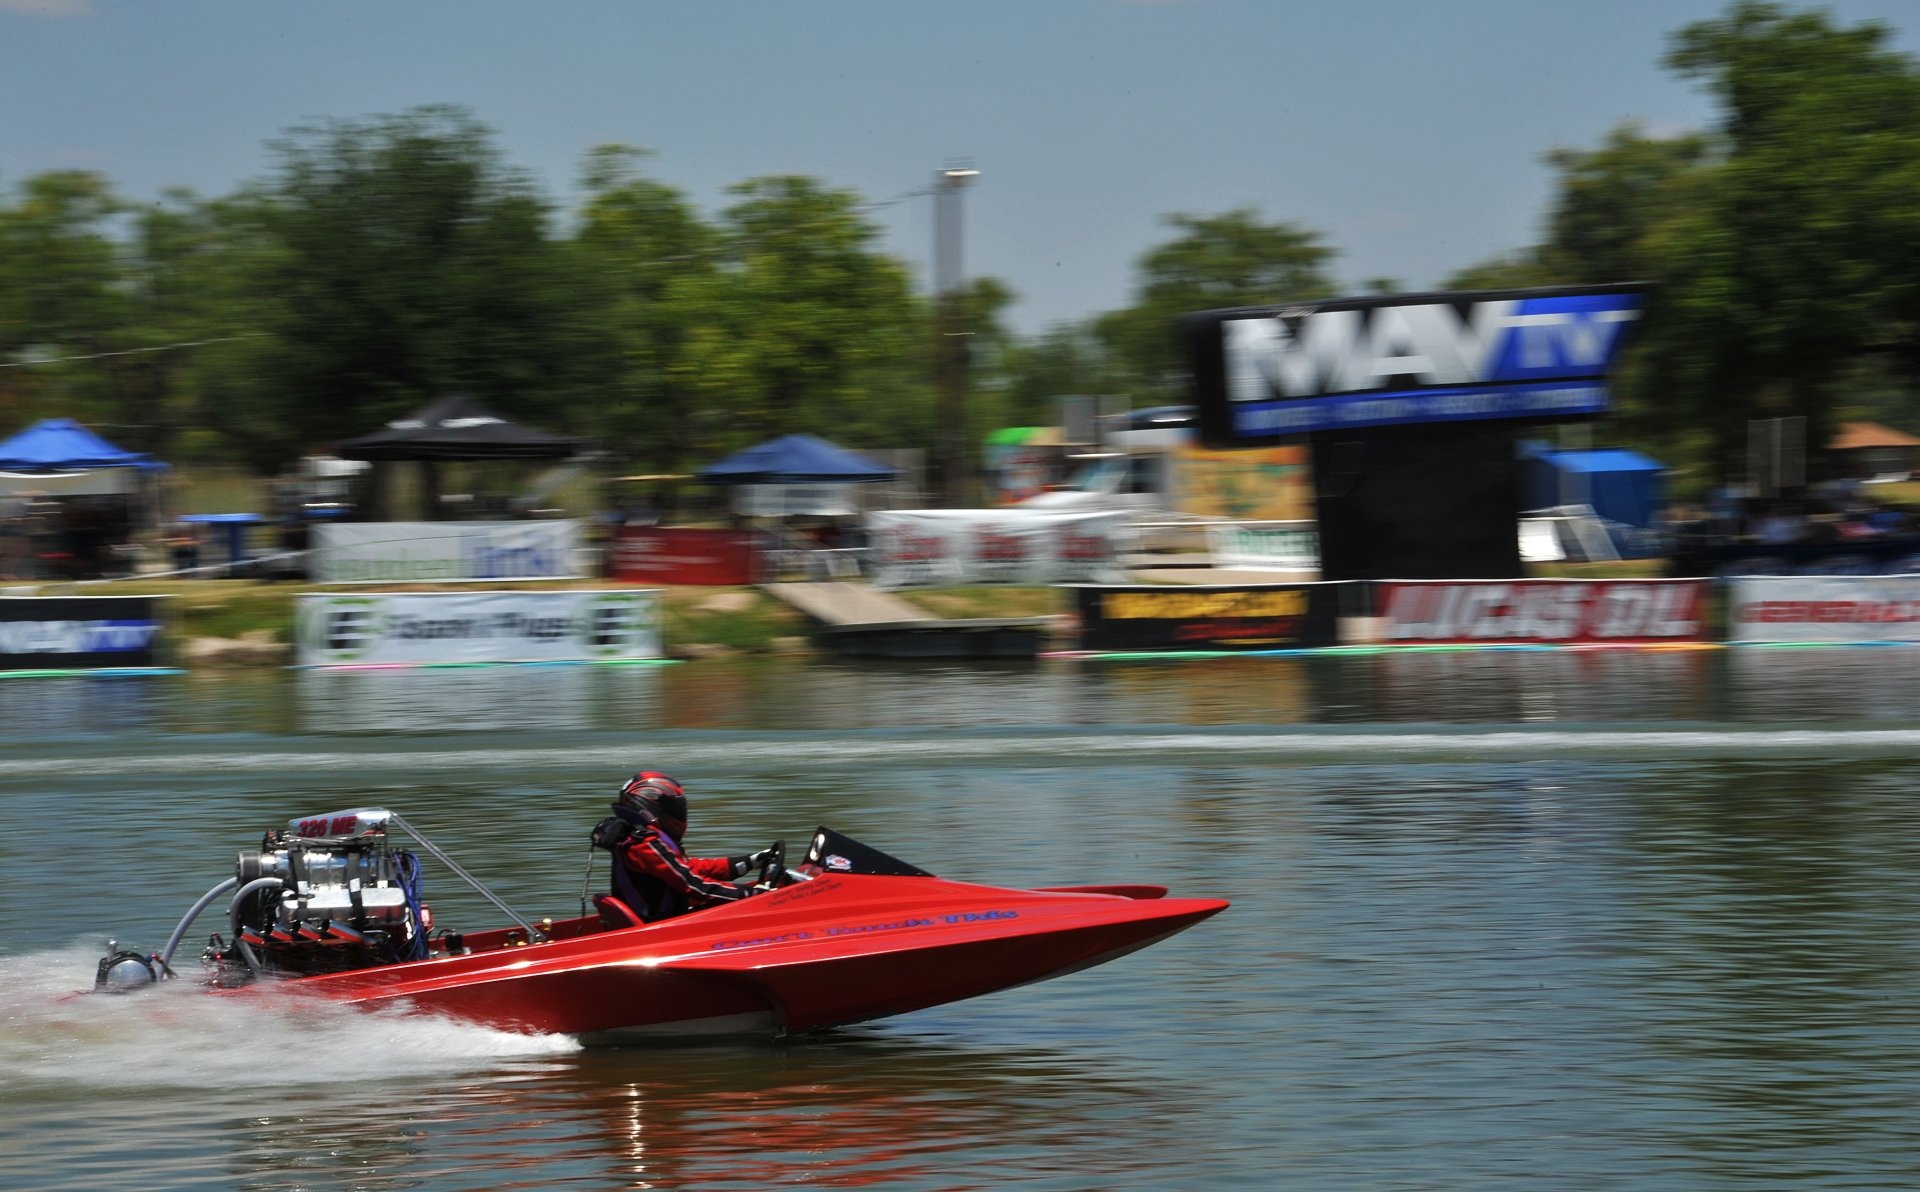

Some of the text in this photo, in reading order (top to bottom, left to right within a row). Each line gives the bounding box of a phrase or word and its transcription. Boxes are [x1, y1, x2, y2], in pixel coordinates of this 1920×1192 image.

[1221, 298, 1643, 401] MAVTV
[298, 815, 358, 838] 326 ME
